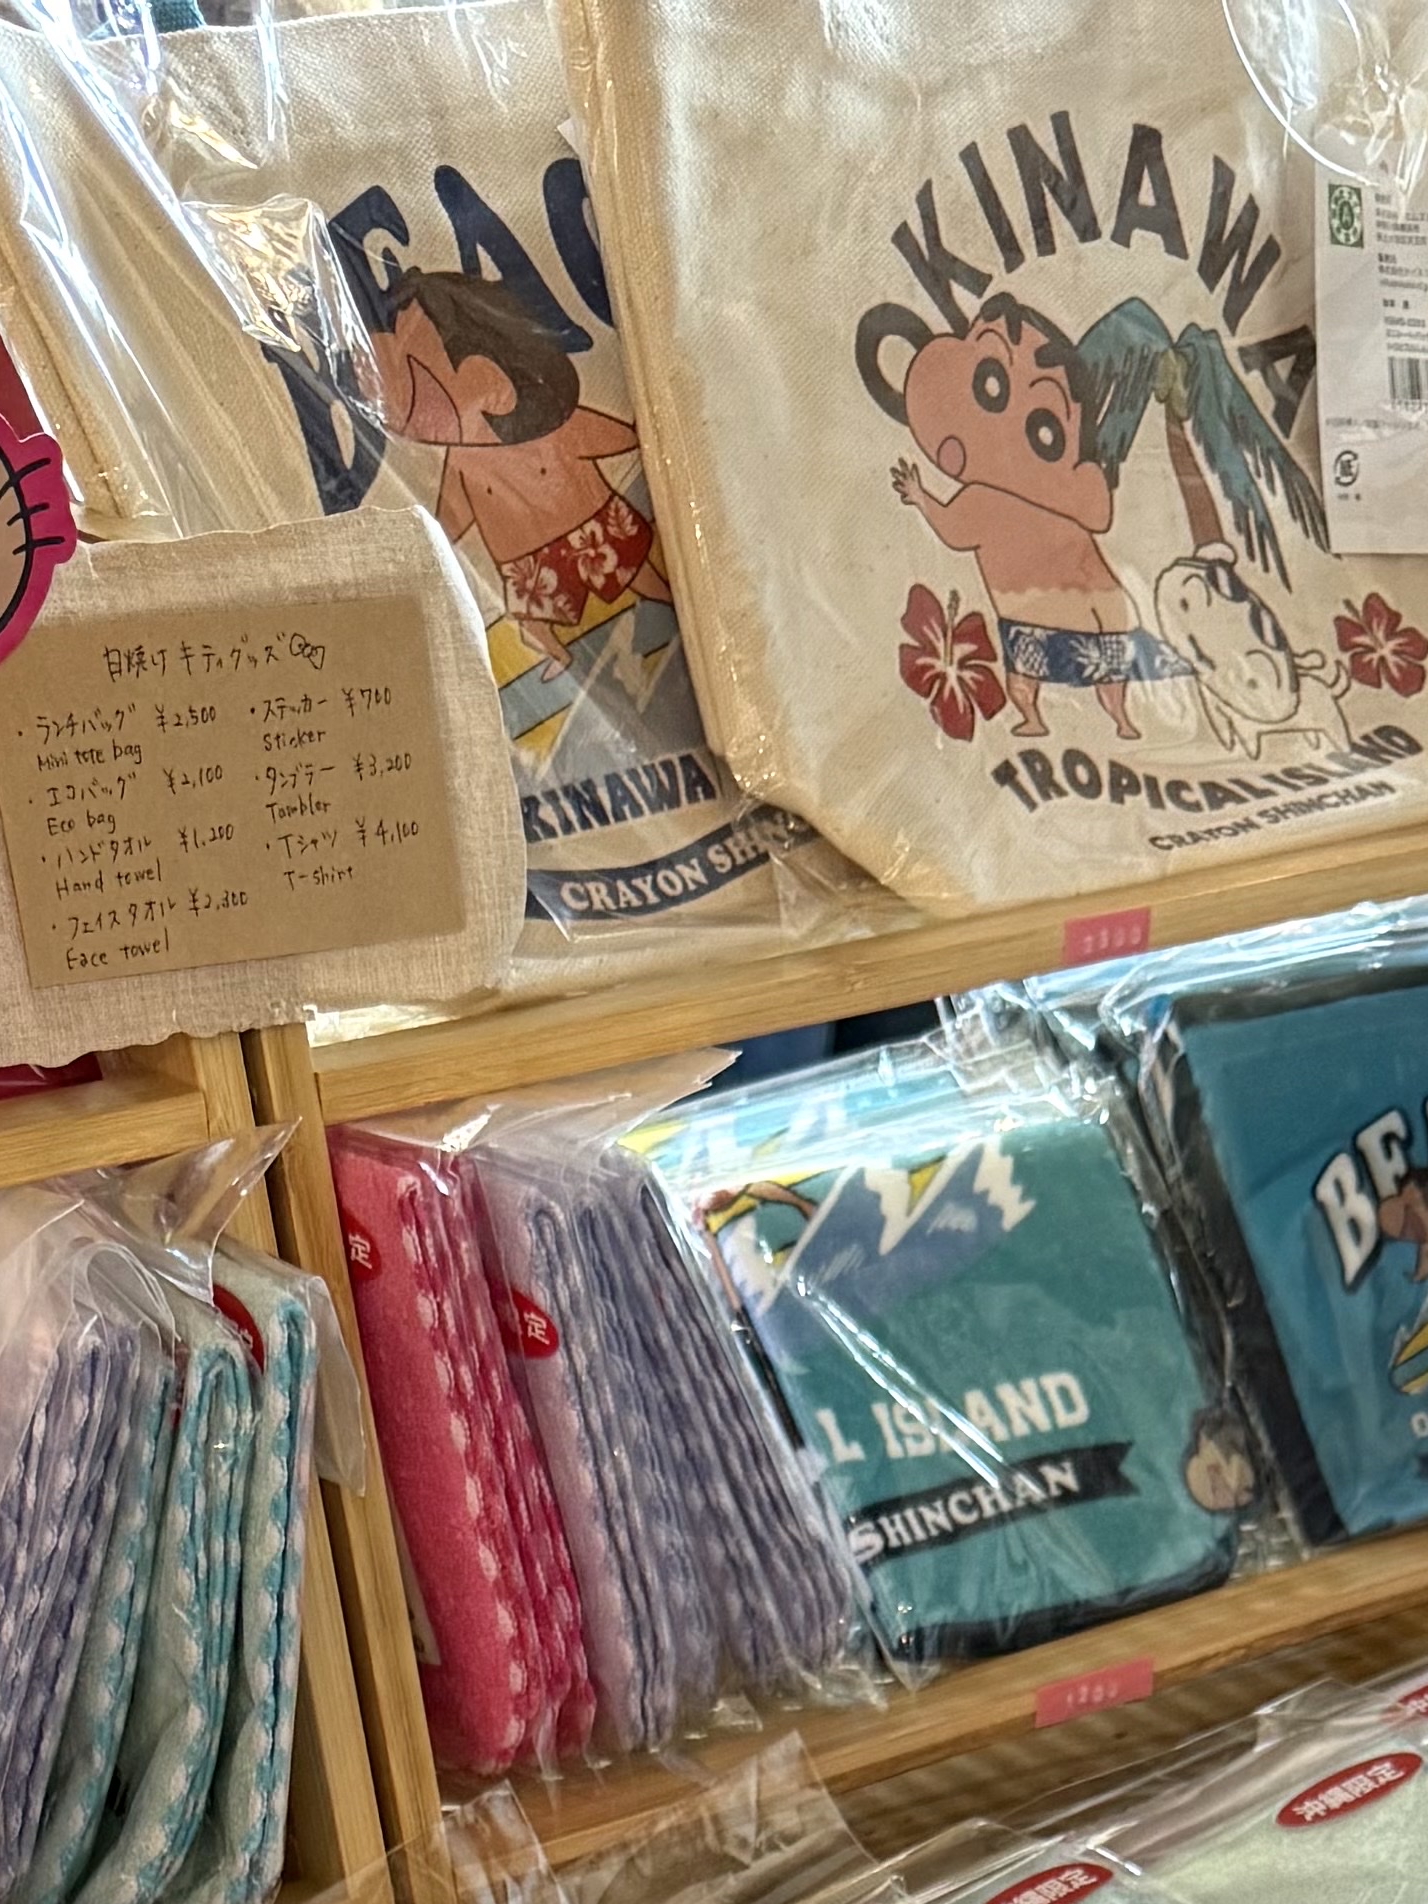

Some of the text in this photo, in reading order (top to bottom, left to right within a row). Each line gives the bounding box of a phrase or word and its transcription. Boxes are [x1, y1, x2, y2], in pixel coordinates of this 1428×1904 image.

[855, 109, 1317, 440] OKINAWA
[112, 739, 142, 765] bag
[992, 723, 1427, 816] TROPICAL ISLAND
[47, 810, 116, 836] Eco bag
[523, 753, 717, 844] KINAWA
[56, 857, 162, 900] Hand towel
[559, 858, 709, 913] CRAYON
[120, 927, 170, 960] towel
[347, 1231, 374, 1272] 定
[518, 1306, 556, 1346] 定
[815, 1407, 866, 1465] L
[1293, 1758, 1407, 1825] 沖縄限定
